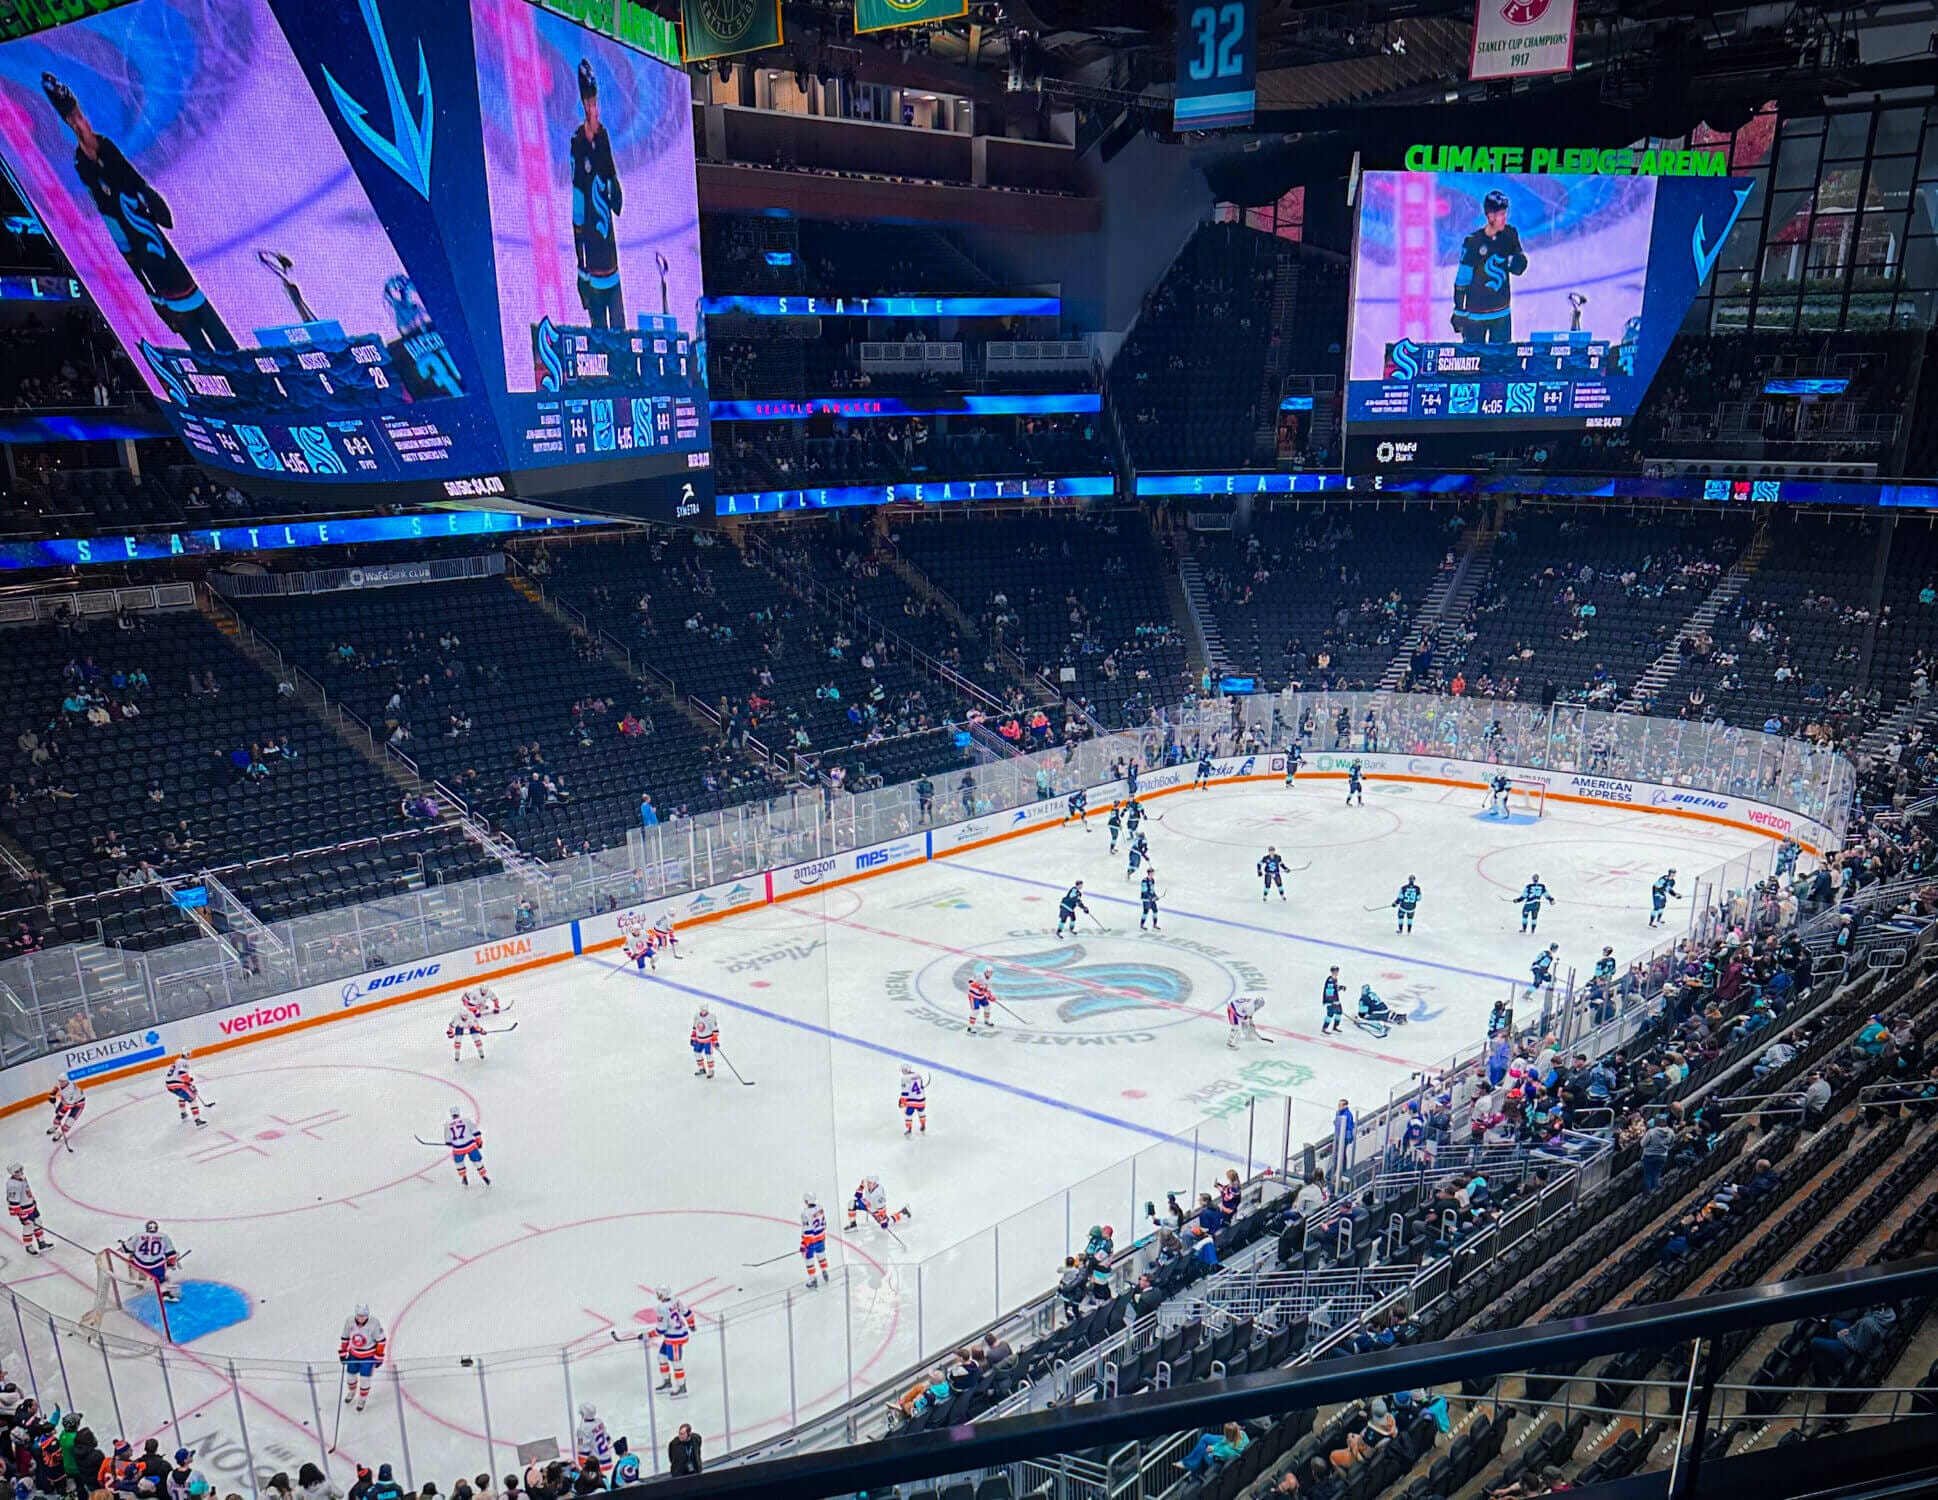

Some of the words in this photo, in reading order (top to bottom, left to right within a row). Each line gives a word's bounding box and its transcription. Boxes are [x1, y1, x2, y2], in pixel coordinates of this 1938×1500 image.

[1189, 2, 1245, 80] 32
[1477, 40, 1506, 53] STANLEY
[1508, 38, 1521, 50] CUP
[1523, 34, 1568, 48] CHAMPIONS
[1510, 53, 1530, 67] 1917
[1404, 144, 1524, 173] CLIMATE
[1531, 147, 1633, 175] PLEDGE
[1639, 150, 1727, 176] ARENA
[779, 298, 943, 313] SEATTLE
[350, 345, 382, 364] SHOTS
[1427, 350, 1435, 360] 17
[1438, 357, 1480, 371] SCHWARTZ
[368, 366, 390, 389] 28
[756, 403, 813, 415] SEATTLE
[823, 402, 881, 414] KRAKEN
[1421, 394, 1441, 406] 7-6-4
[1482, 400, 1503, 414] 4:05
[1395, 442, 1417, 452] WaFd
[1395, 452, 1413, 461] Bank
[886, 480, 1055, 501] SEATTLE
[1194, 475, 1383, 492] SEATTLE
[1734, 481, 1749, 492] VS
[677, 503, 700, 518] SYMETRA
[77, 524, 329, 561] SEATTLE
[1364, 759, 1387, 769] Bank
[1140, 772, 1181, 793] PitchBook
[1571, 777, 1633, 793] AMERICAN
[1579, 788, 1632, 802] EXPRESS
[1671, 793, 1729, 809] BOEING
[1026, 799, 1065, 818] SYMETRA
[1748, 809, 1792, 833] verizon
[856, 848, 889, 870] MPS
[793, 859, 836, 880] amazon
[617, 910, 647, 929] Coors
[726, 940, 826, 974] Alaska
[367, 964, 441, 992] BOEING
[1224, 961, 1268, 992] ARENA
[885, 969, 916, 1001] ARENA
[1012, 1032, 1156, 1046] CLIMATE
[218, 1002, 301, 1035] verizon
[65, 1038, 138, 1068] PREMERA
[911, 1080, 921, 1095] 4
[450, 1124, 466, 1141] 17
[138, 1240, 162, 1256] 40
